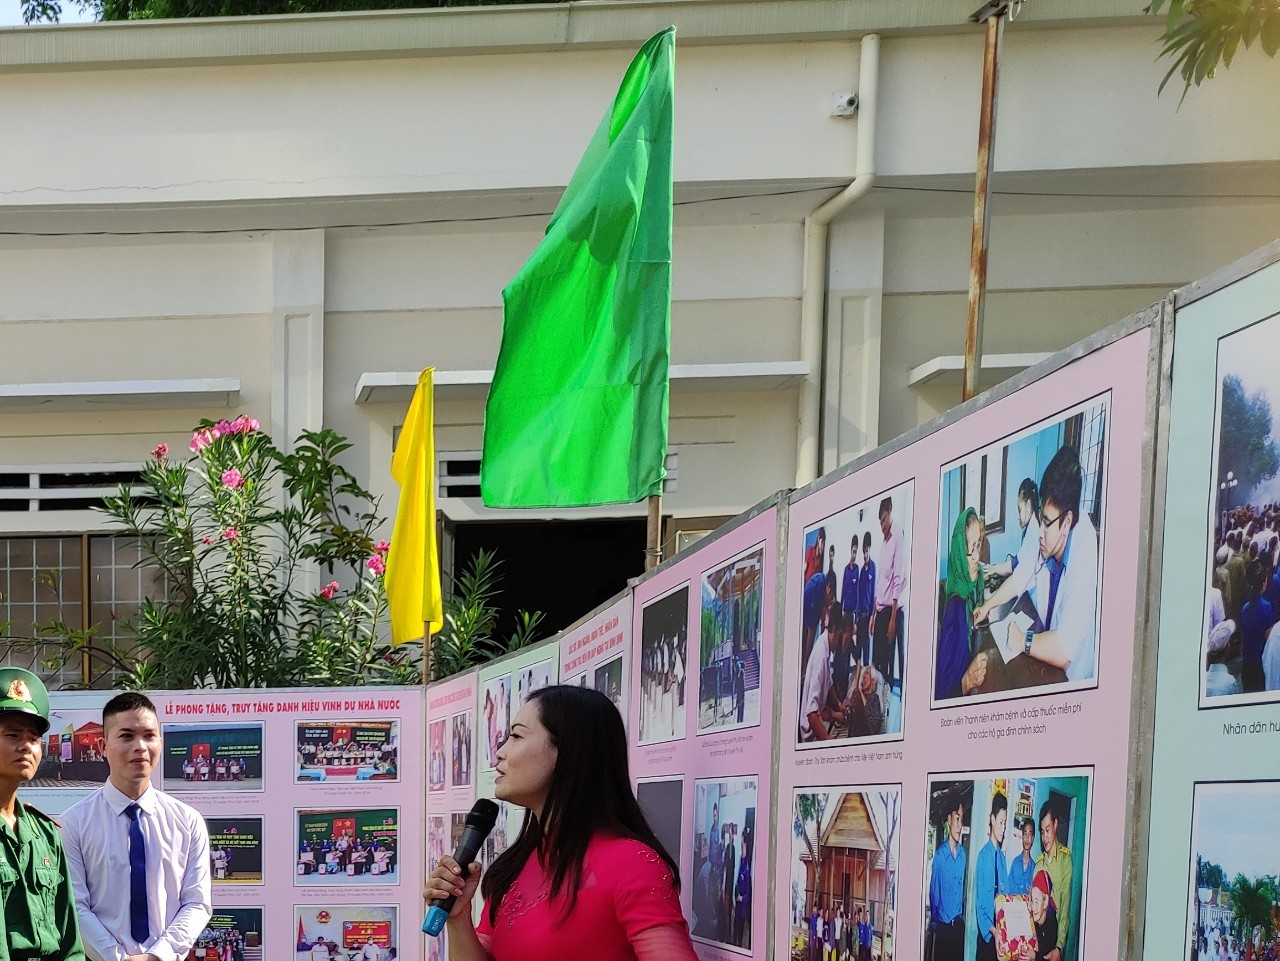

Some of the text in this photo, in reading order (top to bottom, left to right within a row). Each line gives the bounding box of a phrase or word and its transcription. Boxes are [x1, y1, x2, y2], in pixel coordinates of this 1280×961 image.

[165, 702, 173, 714] LỄ
[176, 703, 204, 714] PHONG
[232, 703, 252, 713] TRUY
[254, 701, 274, 714] TẶNG
[277, 702, 298, 712] DANH
[302, 700, 320, 713] HIỆU
[322, 701, 342, 712] VINH
[344, 701, 355, 713] DỰ
[358, 698, 375, 711] NHÀ
[378, 697, 400, 710] NƯỚC
[968, 724, 1046, 739] cho các hộ gia đình chính sách
[1223, 722, 1246, 735] Nhân
[1249, 721, 1266, 733] dân
